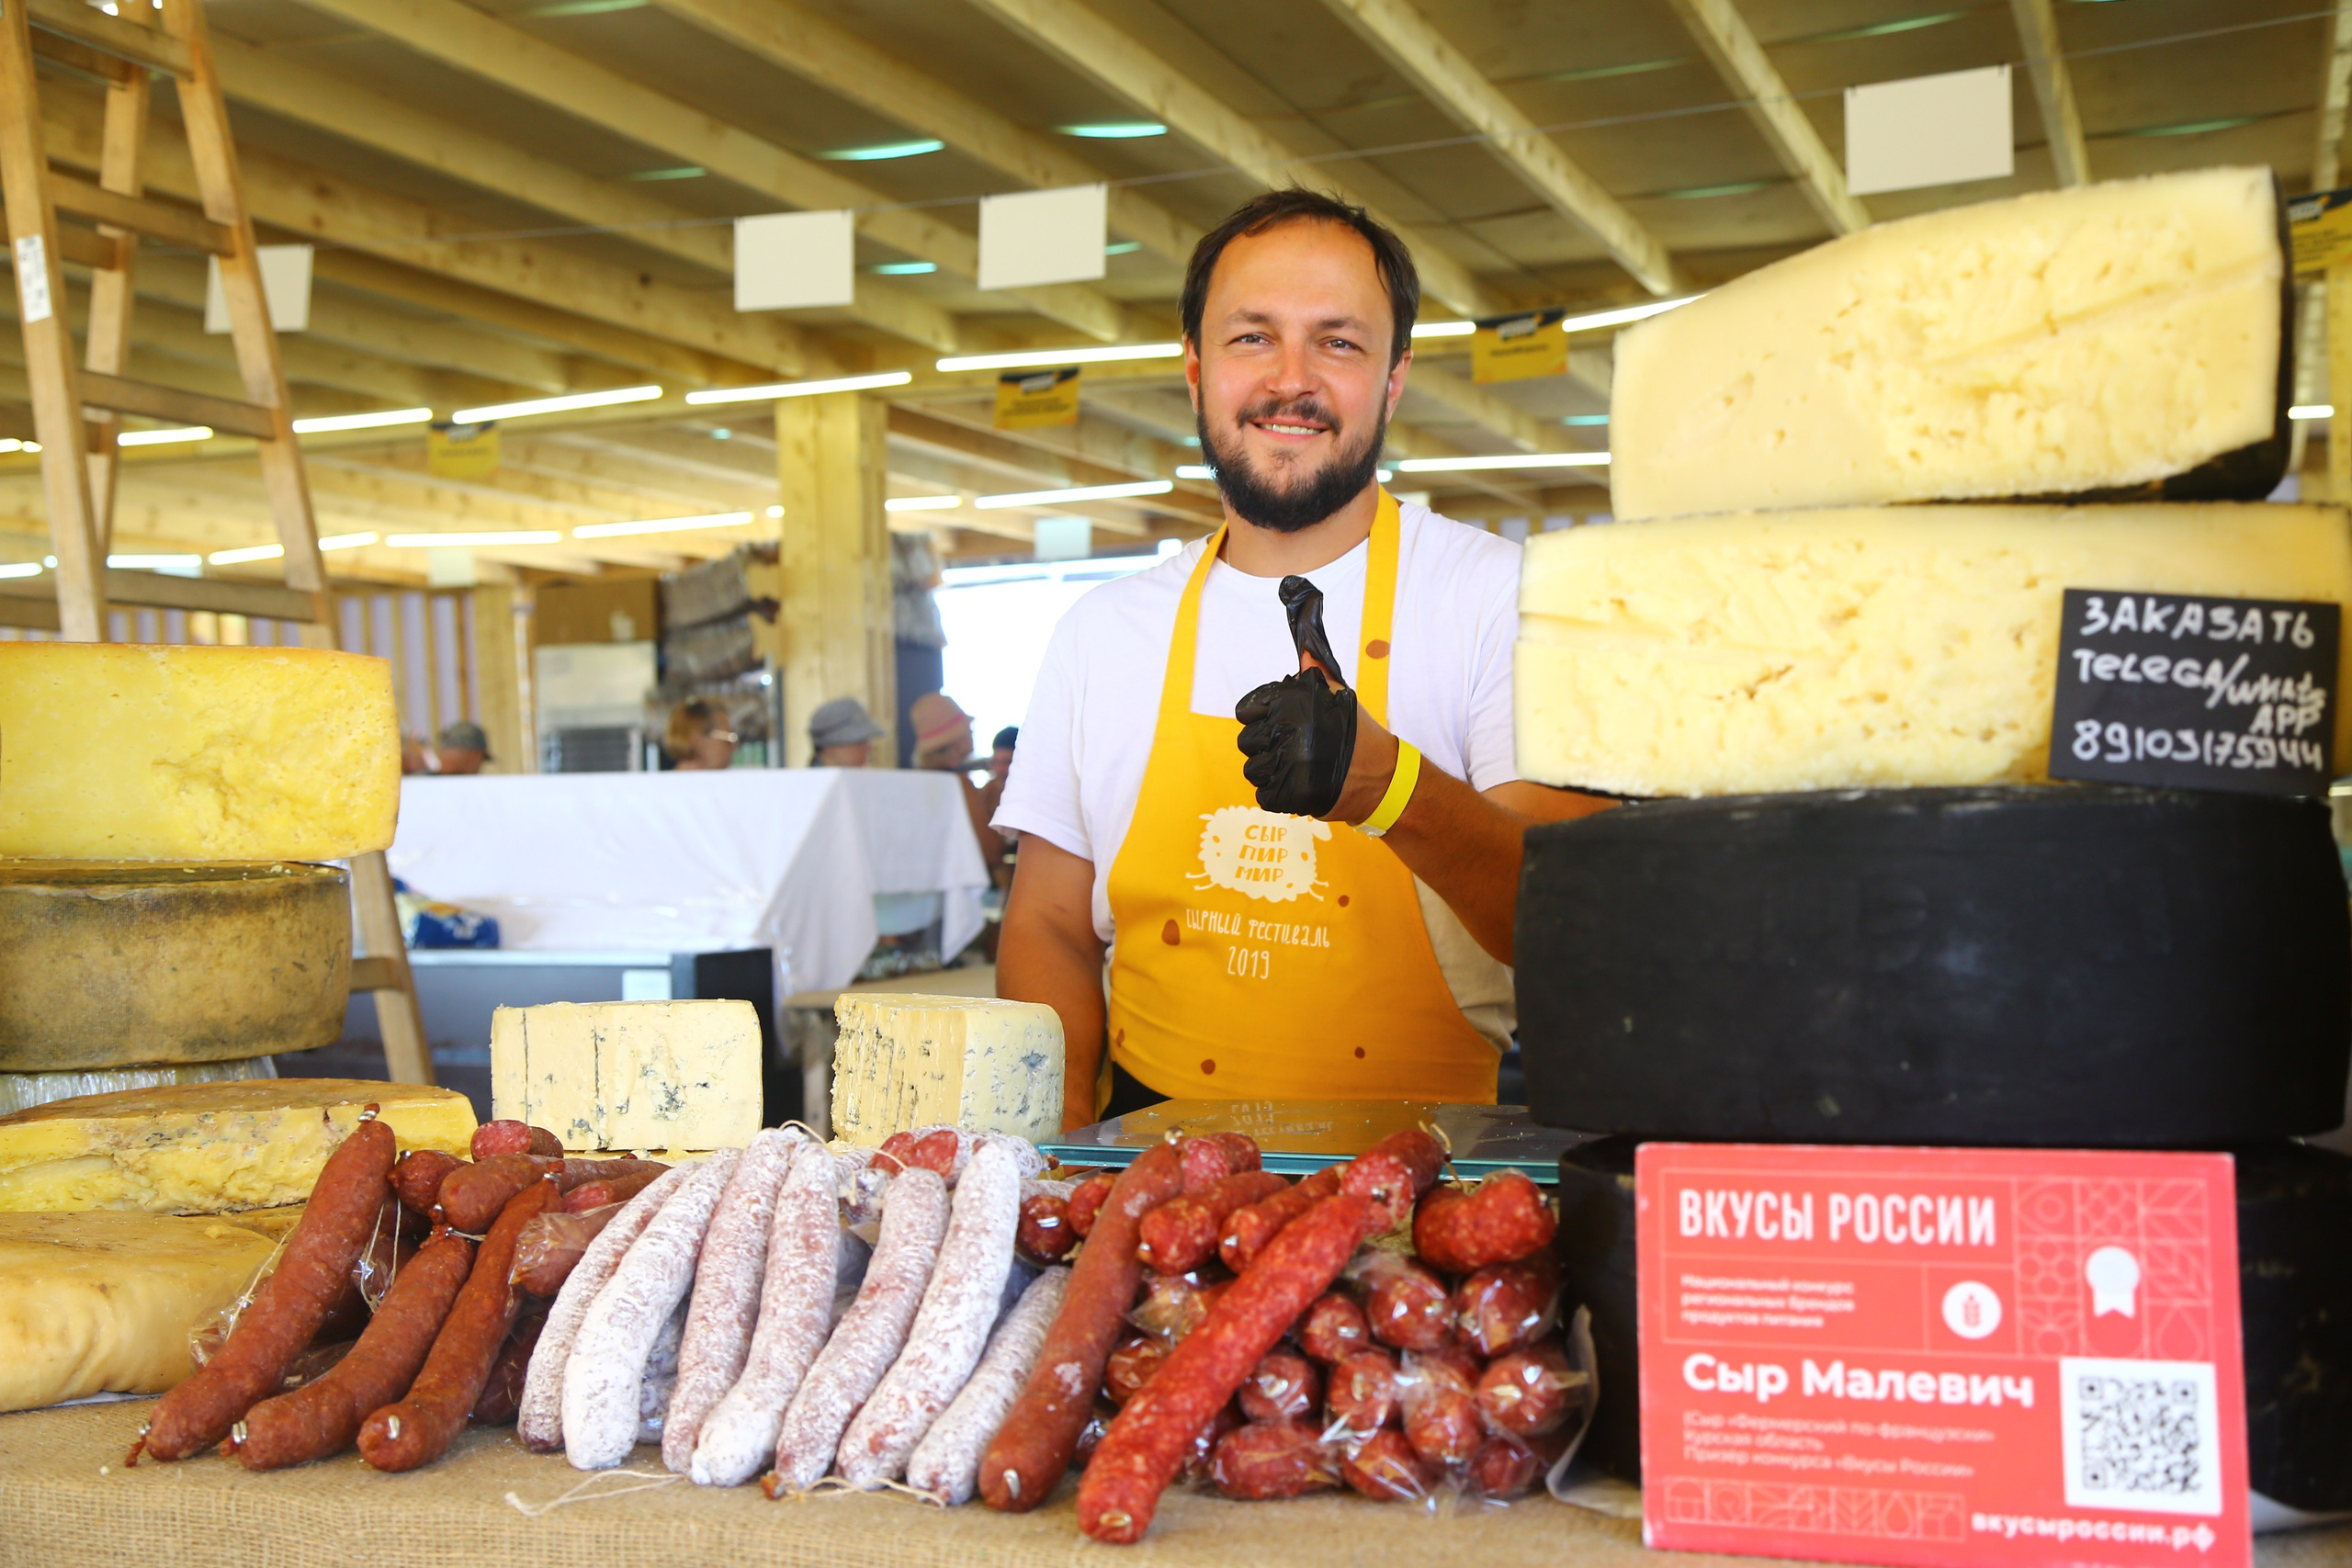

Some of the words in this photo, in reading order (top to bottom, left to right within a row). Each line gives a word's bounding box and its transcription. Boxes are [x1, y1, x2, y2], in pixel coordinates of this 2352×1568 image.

[2079, 595, 2316, 649] ЗАКАЗАТЬ
[2248, 703, 2322, 736] APP
[2072, 718, 2324, 772] 89103175944
[1245, 824, 1288, 842] СЫР
[1238, 844, 1288, 863] ПИР
[1235, 865, 1284, 883] МИР
[1227, 946, 1270, 979] 2019
[1680, 1188, 1814, 1241] ВКУСЫ
[1829, 1192, 1996, 1247] РОССИИ
[1680, 1273, 1790, 1292] Национальный
[1792, 1280, 1855, 1296] конкурс
[1680, 1292, 1786, 1308] региональных
[1788, 1293, 1856, 1313] брендов
[1680, 1309, 1759, 1327] продуктов
[1760, 1313, 1825, 1328] питания
[1682, 1353, 1789, 1404] Сыр
[1802, 1359, 2033, 1408] Малевич
[1682, 1428, 1753, 1447] Курская
[1754, 1430, 1826, 1451] область
[1972, 1511, 2216, 1553] вкусыроссии.рф
